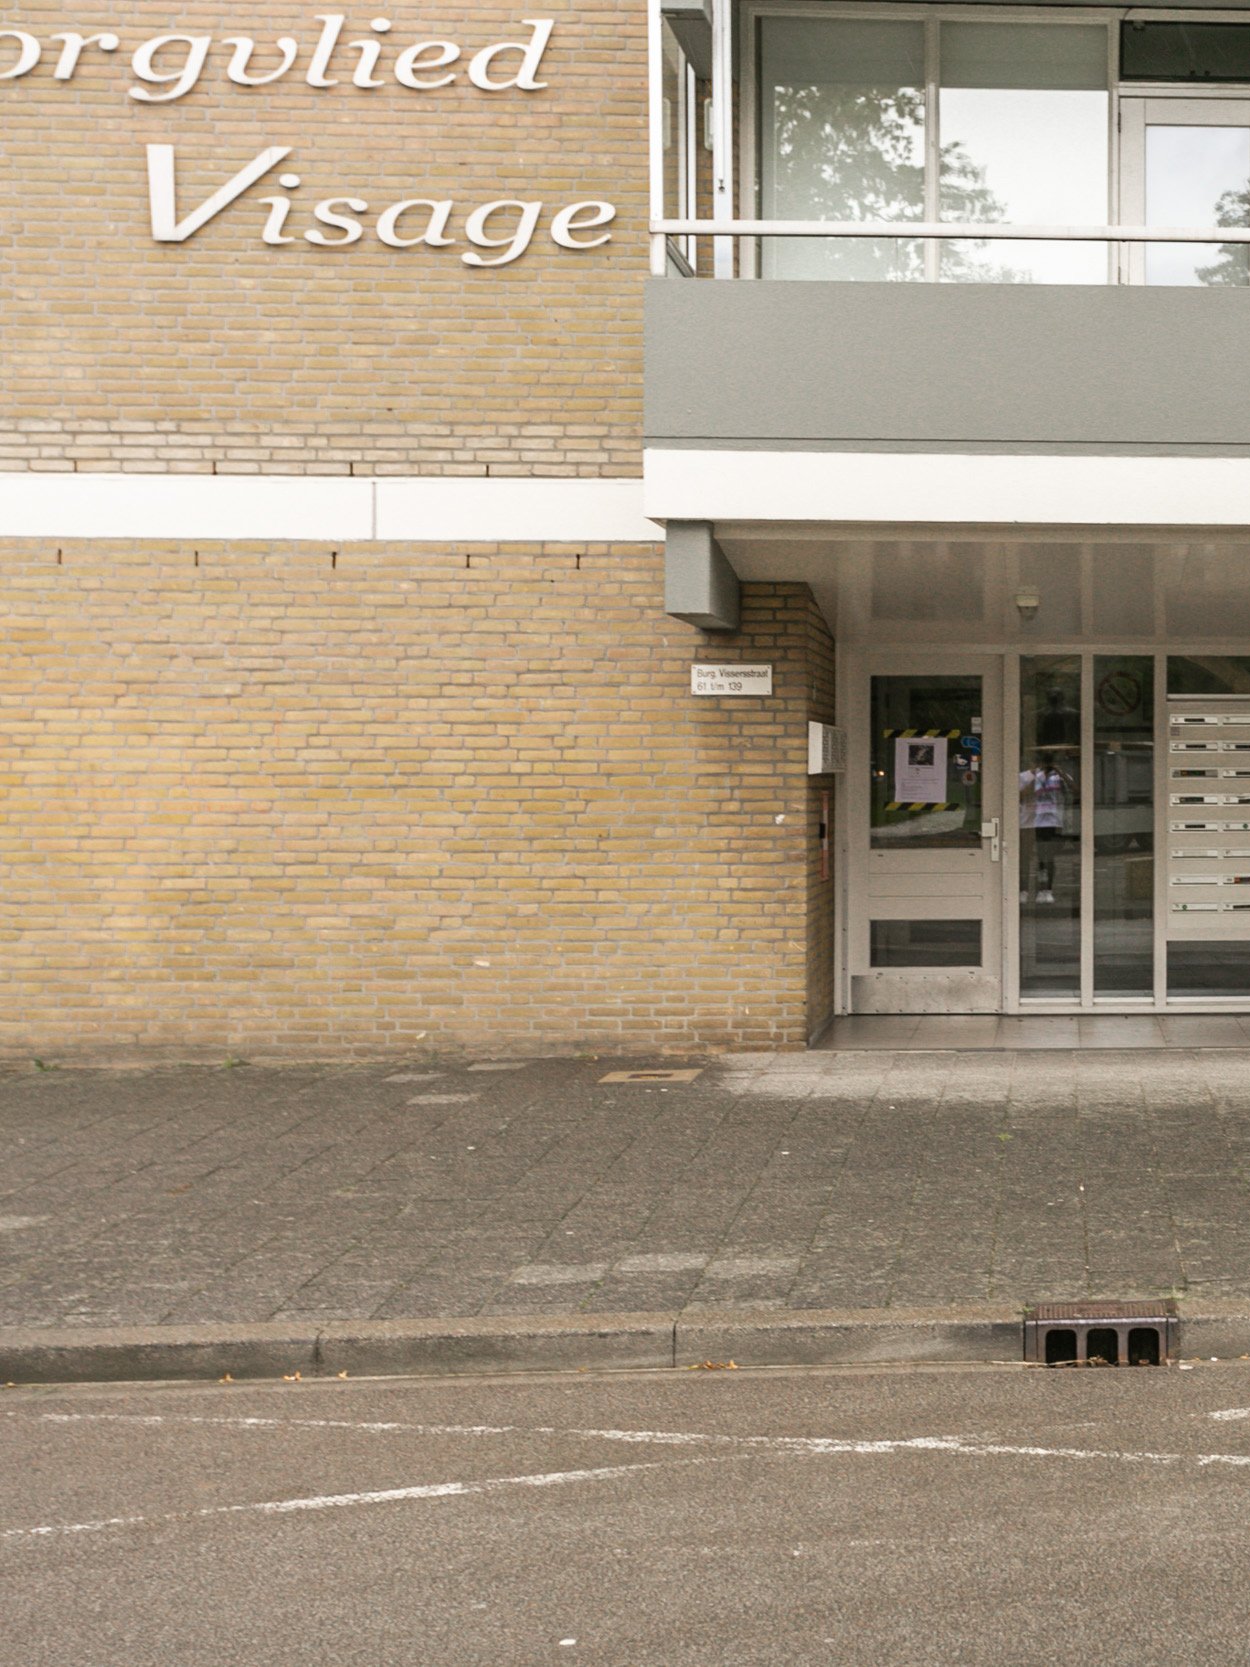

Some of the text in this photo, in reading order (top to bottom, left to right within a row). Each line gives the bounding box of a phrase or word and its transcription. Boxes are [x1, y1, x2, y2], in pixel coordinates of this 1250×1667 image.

[0, 14, 555, 101] orgvlied
[146, 144, 616, 267] Visage
[696, 682, 707, 691] 61
